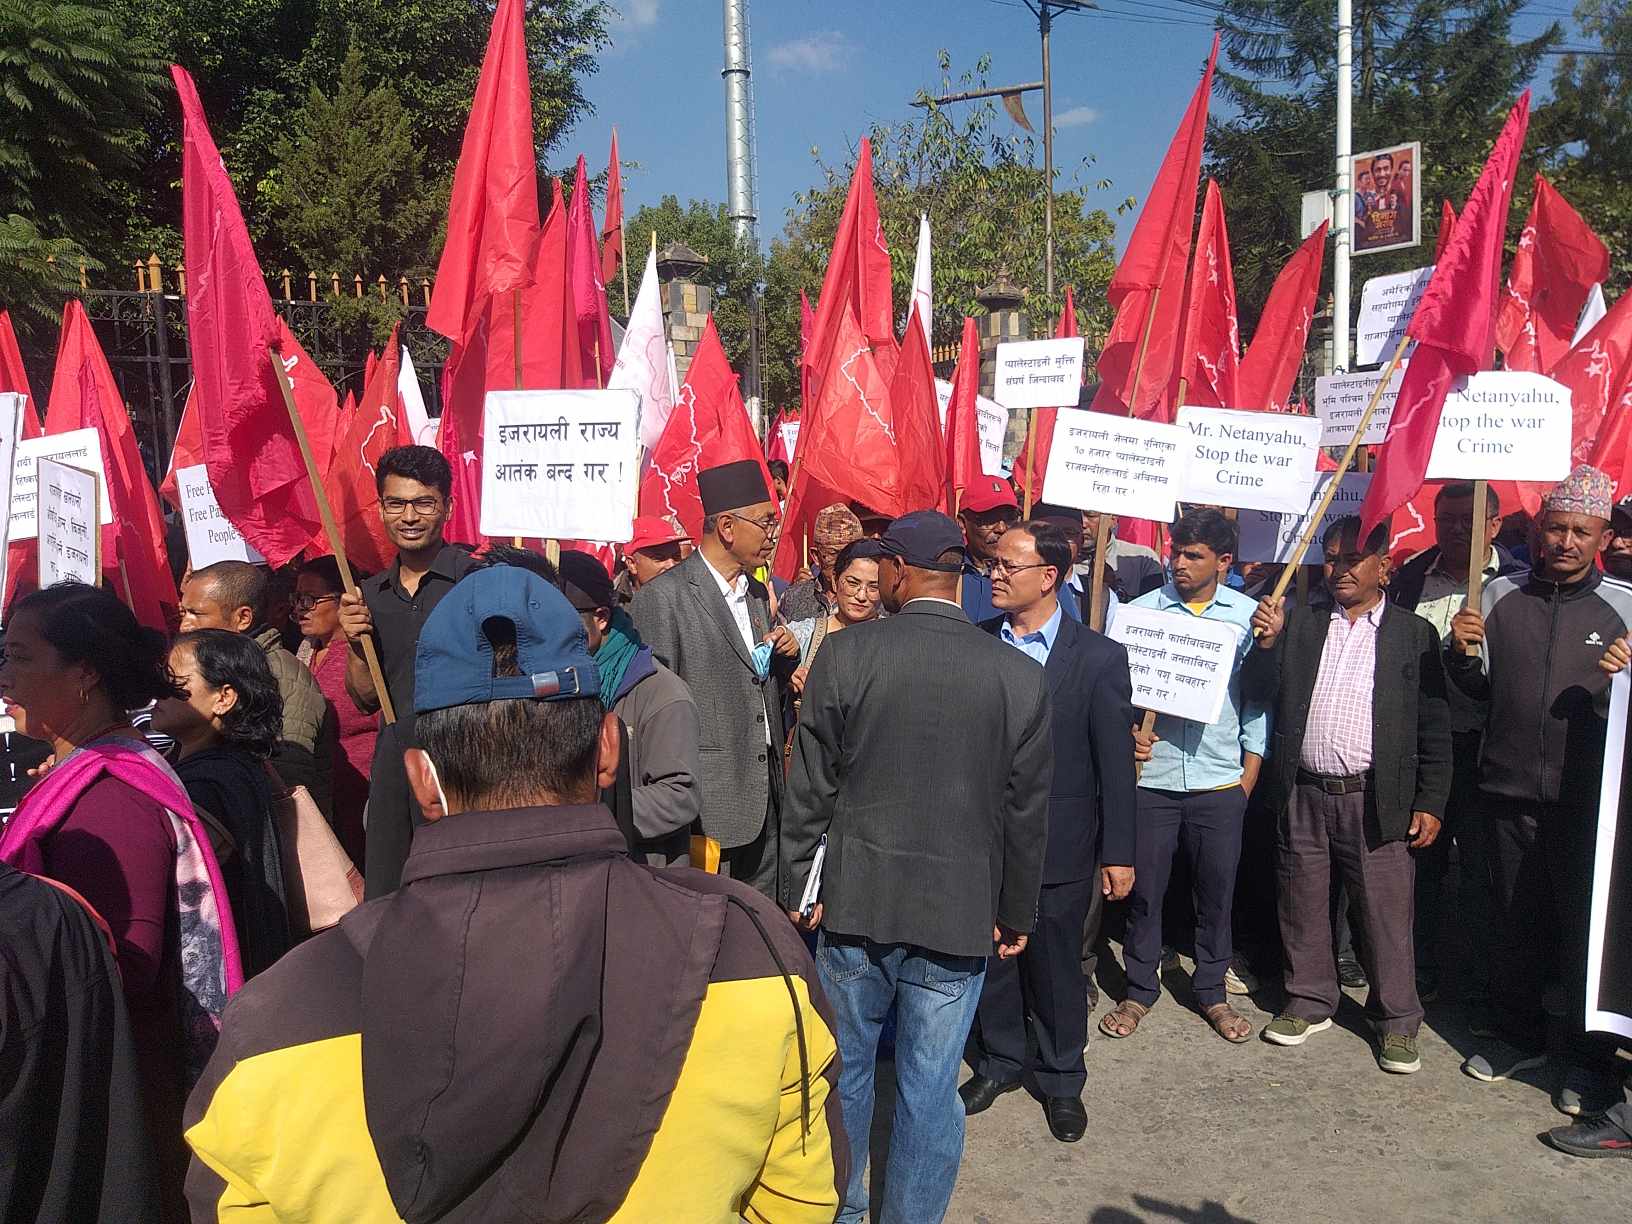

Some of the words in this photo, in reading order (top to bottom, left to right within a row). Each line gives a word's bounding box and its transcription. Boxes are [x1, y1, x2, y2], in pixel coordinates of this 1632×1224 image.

[1456, 387, 1561, 408] Netanyahu,
[498, 415, 571, 446] इजरायली
[578, 421, 622, 444] राज्य
[1438, 414, 1471, 433] top
[1476, 412, 1505, 429] the
[1510, 417, 1546, 430] war
[1188, 421, 1213, 437] Mr.
[1218, 424, 1307, 447] Netanyahu,
[1194, 444, 1230, 465] Stop
[1234, 448, 1259, 464] the
[1263, 454, 1293, 467] war
[1456, 438, 1515, 454] Crime
[495, 458, 539, 484] आतंक
[583, 463, 611, 484] गर
[1215, 469, 1265, 487] Crime
[185, 484, 205, 499] Free
[188, 508, 209, 523] Free
[207, 526, 237, 546] People
